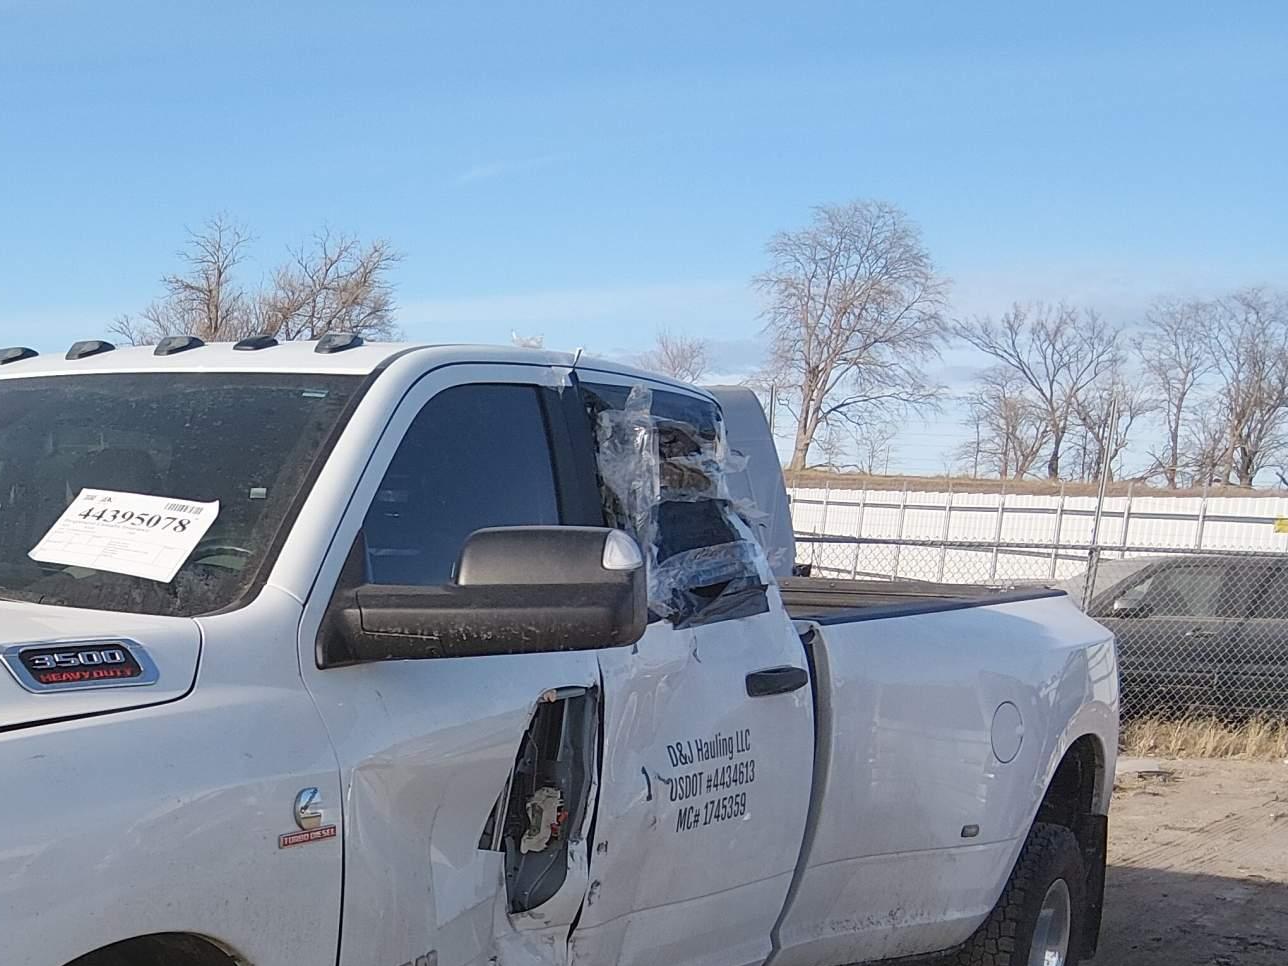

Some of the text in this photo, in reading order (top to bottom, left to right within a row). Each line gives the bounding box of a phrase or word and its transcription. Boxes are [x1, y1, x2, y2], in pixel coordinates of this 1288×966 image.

[78, 506, 191, 533] 44395078
[29, 649, 126, 669] 3500
[40, 667, 133, 683] HEAVY DUTY
[667, 728, 751, 768] D&J Hauling LLC
[669, 759, 755, 802] USDOT #4434613
[675, 792, 746, 833] MC# 1745359
